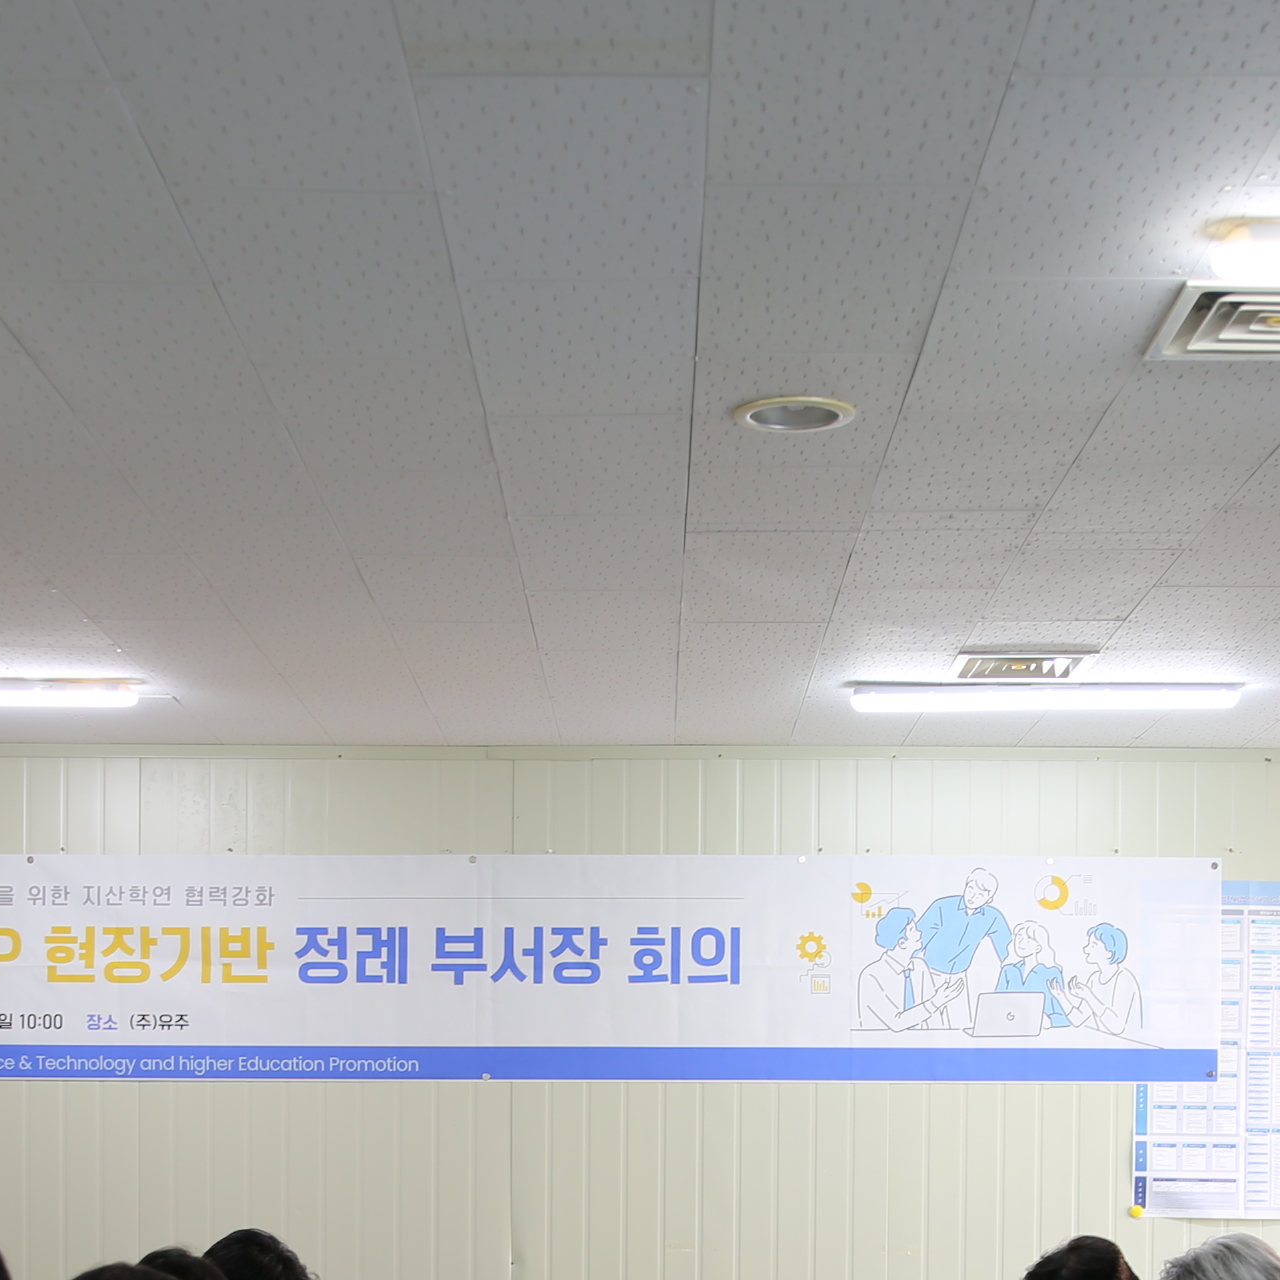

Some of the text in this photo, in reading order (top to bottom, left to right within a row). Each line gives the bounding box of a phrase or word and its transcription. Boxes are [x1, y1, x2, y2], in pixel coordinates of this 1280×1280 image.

[28, 885, 70, 907] 위한
[83, 885, 172, 908] 지산학연
[184, 885, 276, 908] 협력강화
[45, 924, 275, 985] 현장기반
[294, 925, 409, 986] 정례
[430, 925, 608, 986] 부서장
[628, 925, 743, 986] 회의
[19, 1013, 63, 1030] 10:00
[86, 1012, 118, 1031] 장소
[129, 1012, 190, 1032] (주)유주
[19, 1056, 32, 1071] &
[36, 1056, 136, 1075] Technology
[140, 1056, 174, 1072] and
[179, 1056, 234, 1076] higher
[238, 1057, 325, 1072] Education
[329, 1058, 419, 1073] Promotion
